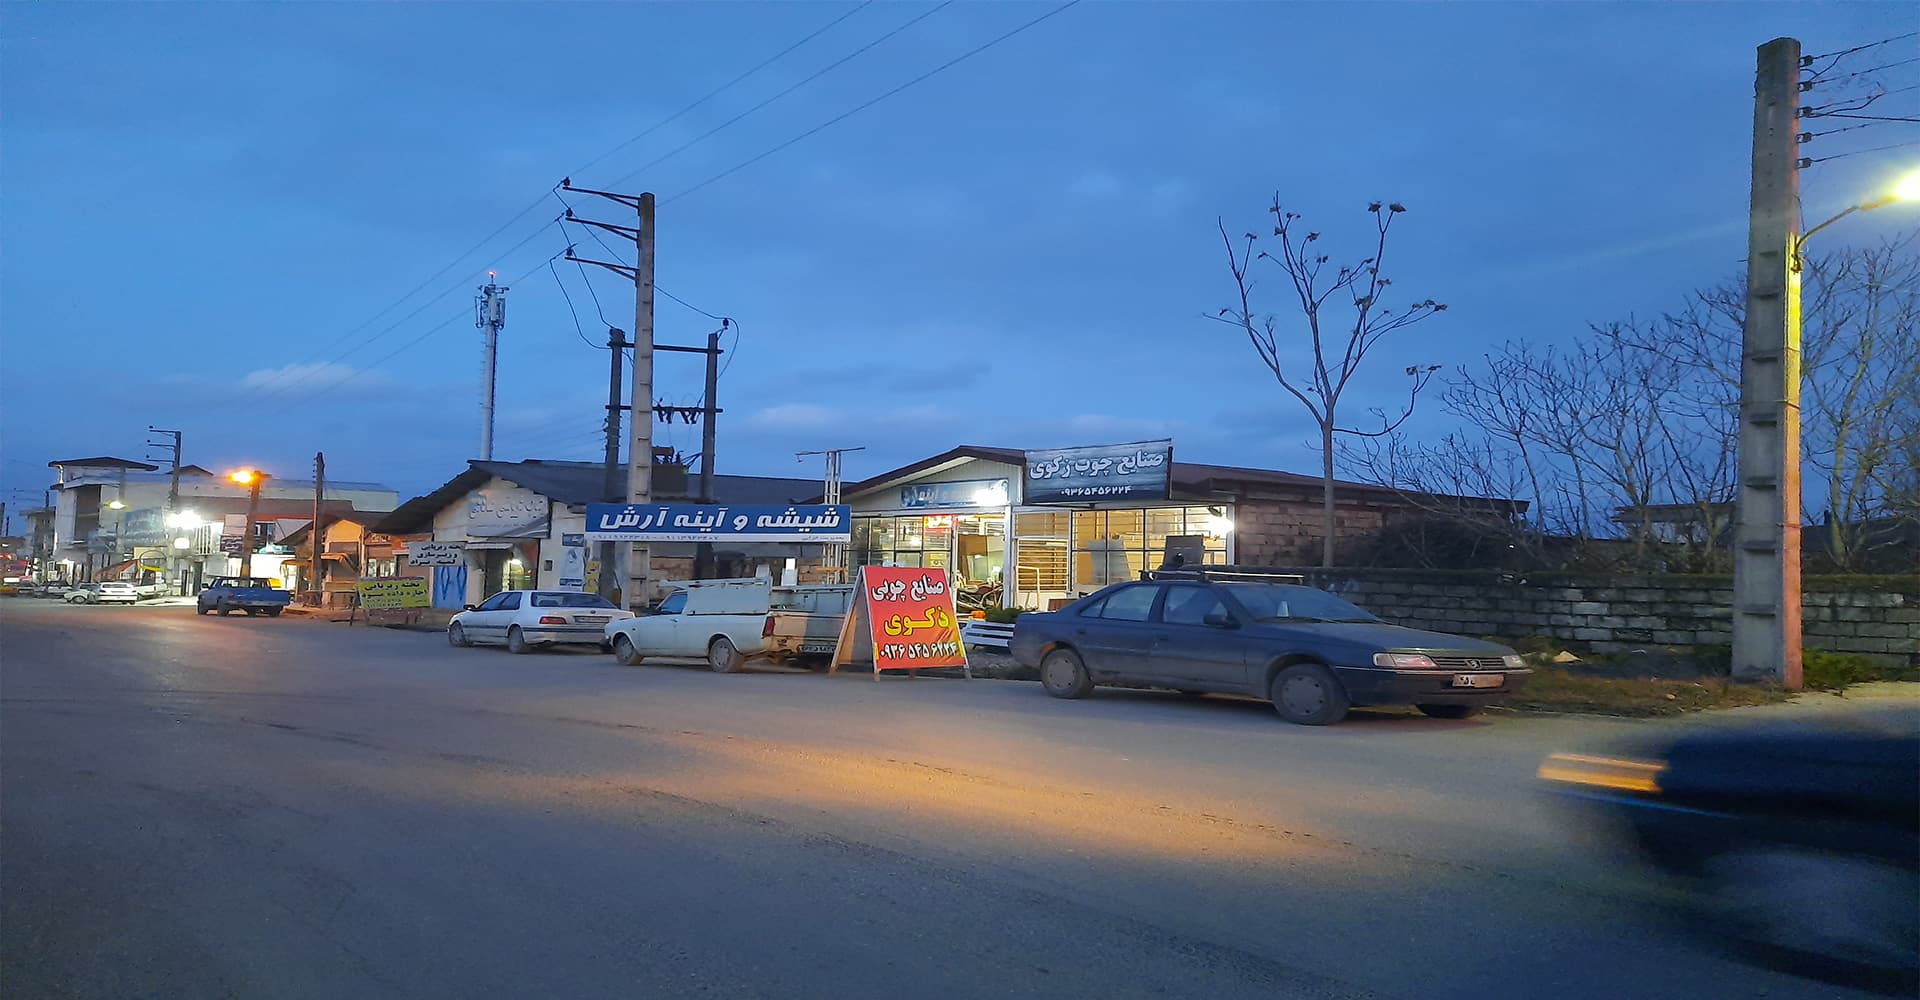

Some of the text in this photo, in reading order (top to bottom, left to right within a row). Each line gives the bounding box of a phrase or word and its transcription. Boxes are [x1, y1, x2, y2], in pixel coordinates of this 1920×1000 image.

[1030, 450, 1164, 479] صنایع چوب زکوی
[599, 506, 841, 532] شیشه و آینه آرش
[871, 574, 945, 603] صنایع چوبی
[883, 606, 951, 637] ذکوی
[880, 643, 905, 659] ۰۹۳۶
[908, 643, 930, 658] ۵۴۵
